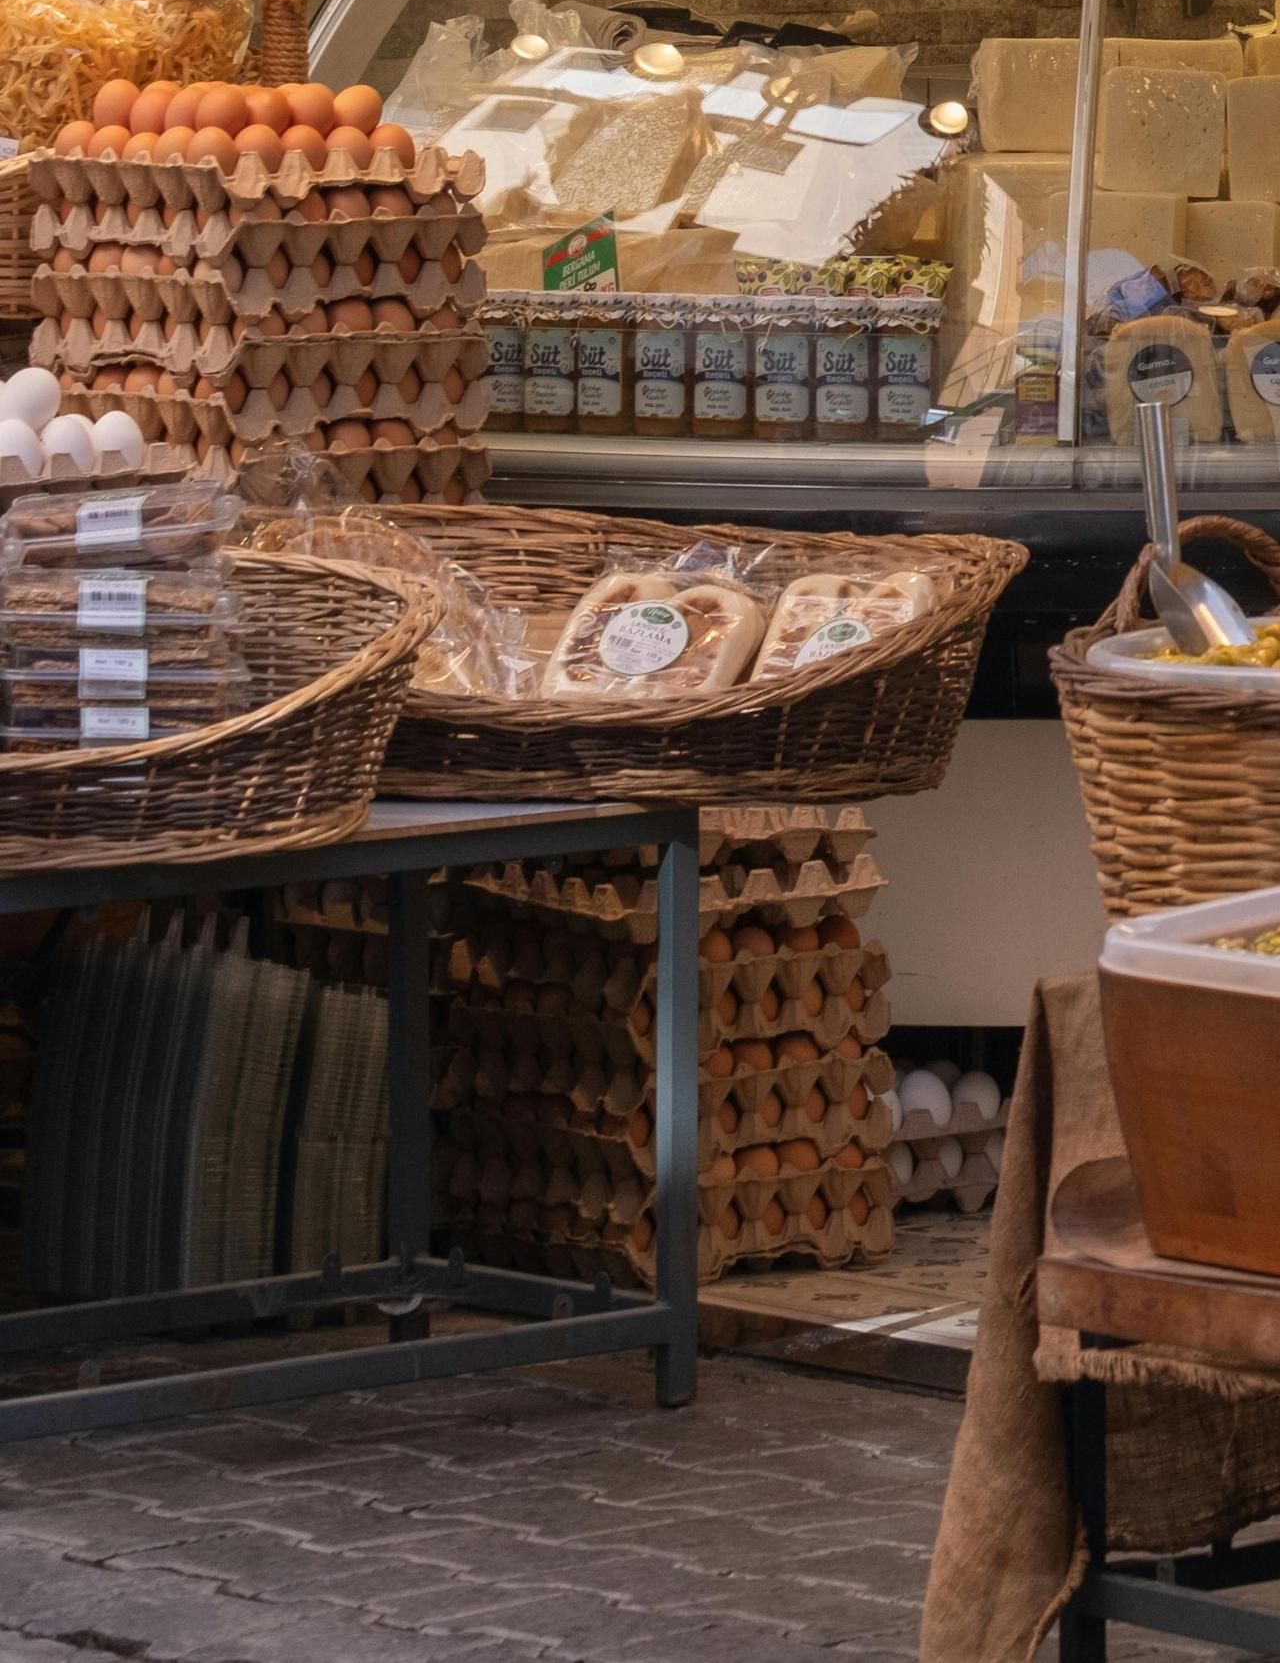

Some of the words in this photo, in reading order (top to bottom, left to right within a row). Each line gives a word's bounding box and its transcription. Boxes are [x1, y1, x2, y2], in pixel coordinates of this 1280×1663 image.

[562, 250, 596, 277] BERGAMA
[530, 343, 561, 365] Süt
[580, 345, 606, 365] Süt
[640, 346, 672, 368] Süt
[702, 347, 734, 370] Süt
[764, 349, 797, 372] Süt
[823, 350, 856, 373] Süt
[885, 351, 918, 374] Süt
[618, 626, 672, 646] BAZLAMA
